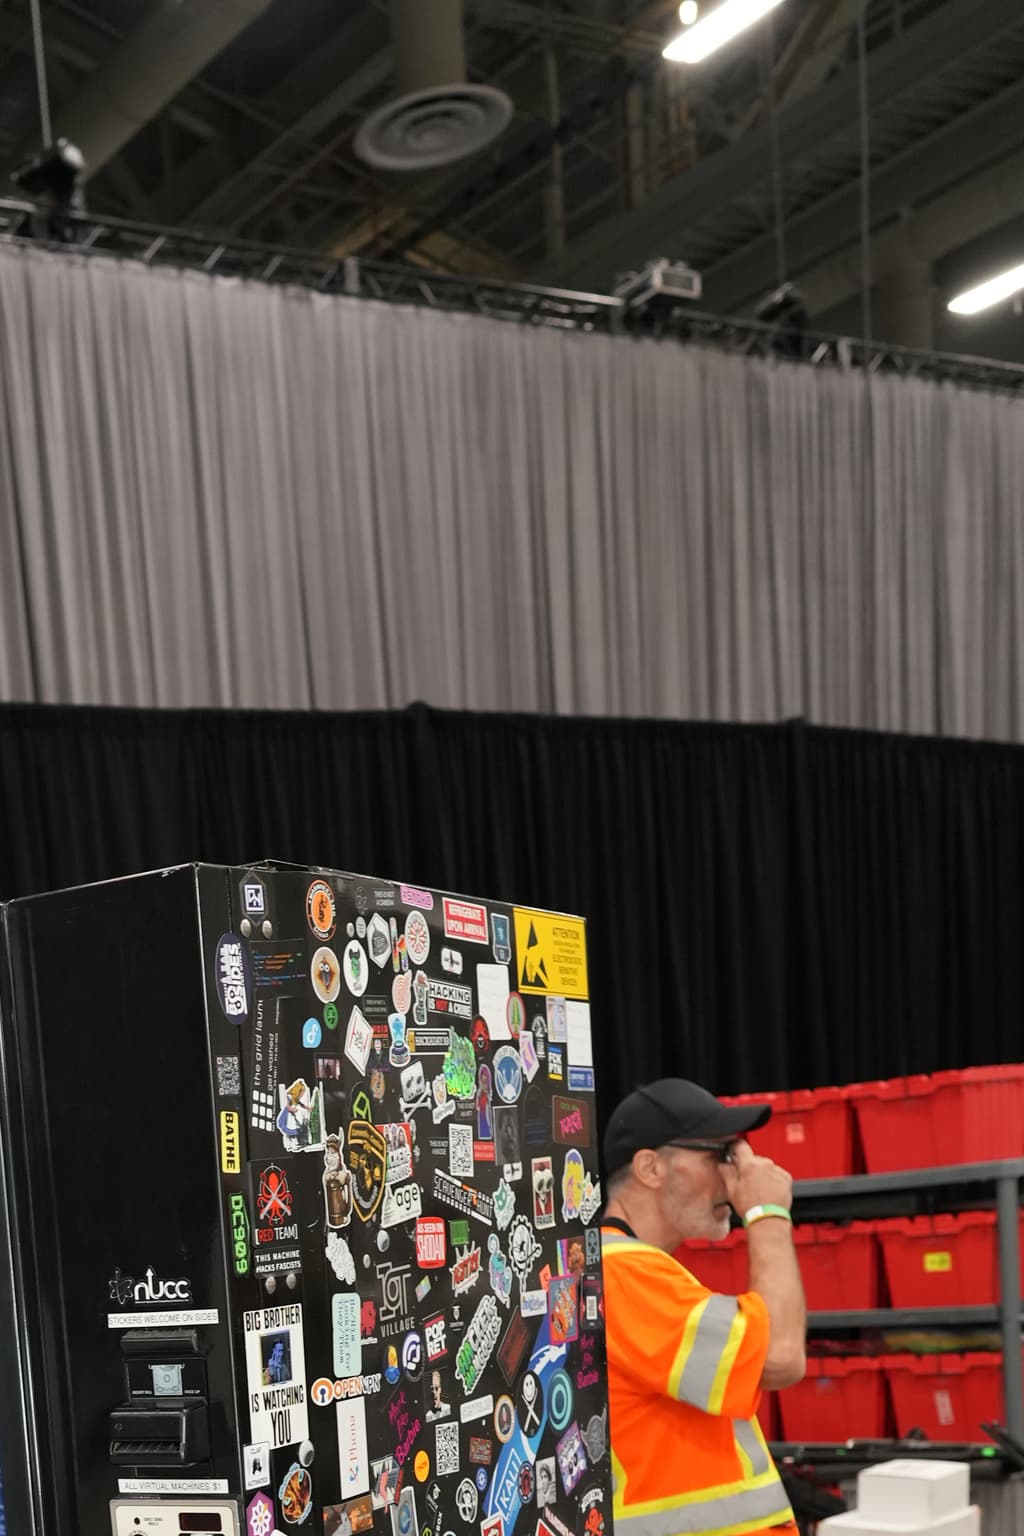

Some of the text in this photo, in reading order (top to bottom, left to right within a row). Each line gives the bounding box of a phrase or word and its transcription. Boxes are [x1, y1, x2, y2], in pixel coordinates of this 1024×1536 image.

[448, 903, 482, 920] REFRIGERATE
[447, 919, 486, 937] UPON ARRIVAL
[429, 984, 472, 1001] HACKING
[428, 999, 435, 1010] IS
[448, 1002, 453, 1012] A
[454, 1003, 472, 1017] CRIME
[254, 1034, 264, 1062] grid
[267, 1033, 275, 1072] washed
[254, 1064, 262, 1086] the
[225, 1113, 236, 1169] BATHE
[275, 1224, 299, 1240] TEAM]
[417, 1225, 425, 1234] AS
[426, 1224, 436, 1233] SEEN
[255, 1250, 300, 1263] THIS MACHINE
[417, 1234, 445, 1261] SHODAN
[256, 1260, 301, 1274] HACKS FASCISTS
[109, 1312, 218, 1326] STICKERS WELCOME ON SIDES
[245, 1305, 301, 1331] BIG BROTHER
[380, 1317, 416, 1338] VILLAGE
[425, 1319, 445, 1338] POP
[427, 1334, 446, 1357] RET
[334, 1373, 382, 1399] OPENVPN
[251, 1385, 304, 1413] IS WATCHING
[271, 1409, 292, 1447] YOU
[396, 1418, 421, 1465] Barbie
[124, 1482, 221, 1491] ALL VIRTUAL MACHINES $1
[499, 1458, 522, 1505] KALI
